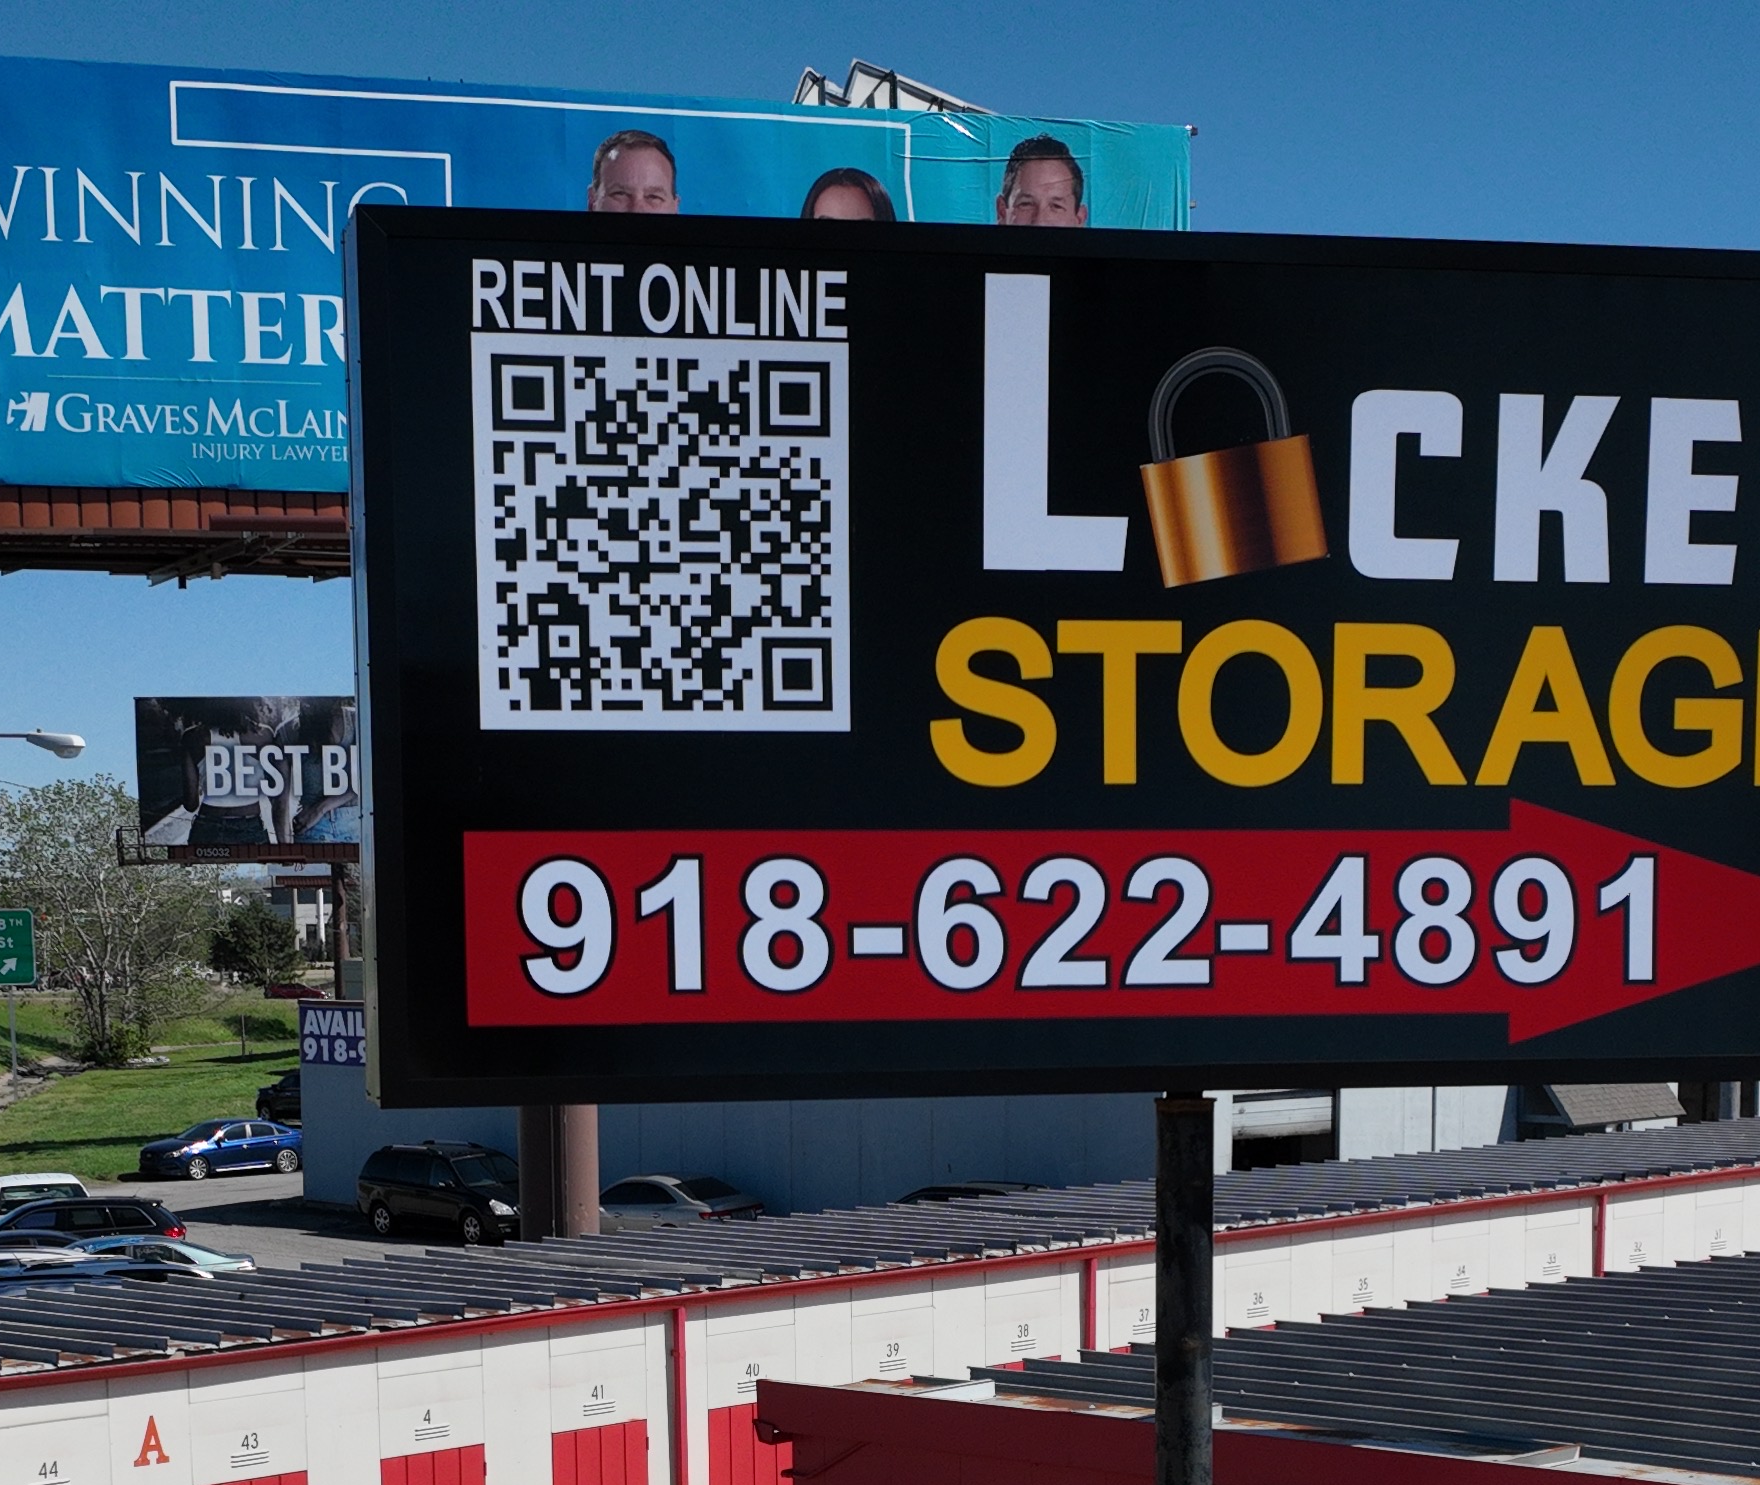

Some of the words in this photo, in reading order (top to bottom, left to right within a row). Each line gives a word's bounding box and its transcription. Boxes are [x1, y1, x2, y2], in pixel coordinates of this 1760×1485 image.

[472, 258, 624, 332] RENT
[639, 263, 848, 338] ONLINE
[191, 443, 266, 463] INJURY
[205, 744, 309, 797] BEST
[196, 847, 231, 858] 015032
[519, 857, 1658, 996] 918-622-4891
[1358, 1277, 1369, 1292] 35
[1252, 1292, 1264, 1306] 36
[1138, 1308, 1150, 1322] 37
[1017, 1323, 1030, 1339] 38
[886, 1342, 900, 1359] 39
[745, 1362, 760, 1378] 40
[591, 1384, 605, 1401] 41
[423, 1408, 432, 1425] 4
[134, 1415, 170, 1468] A
[241, 1432, 259, 1450] 43
[38, 1460, 59, 1479] 44
